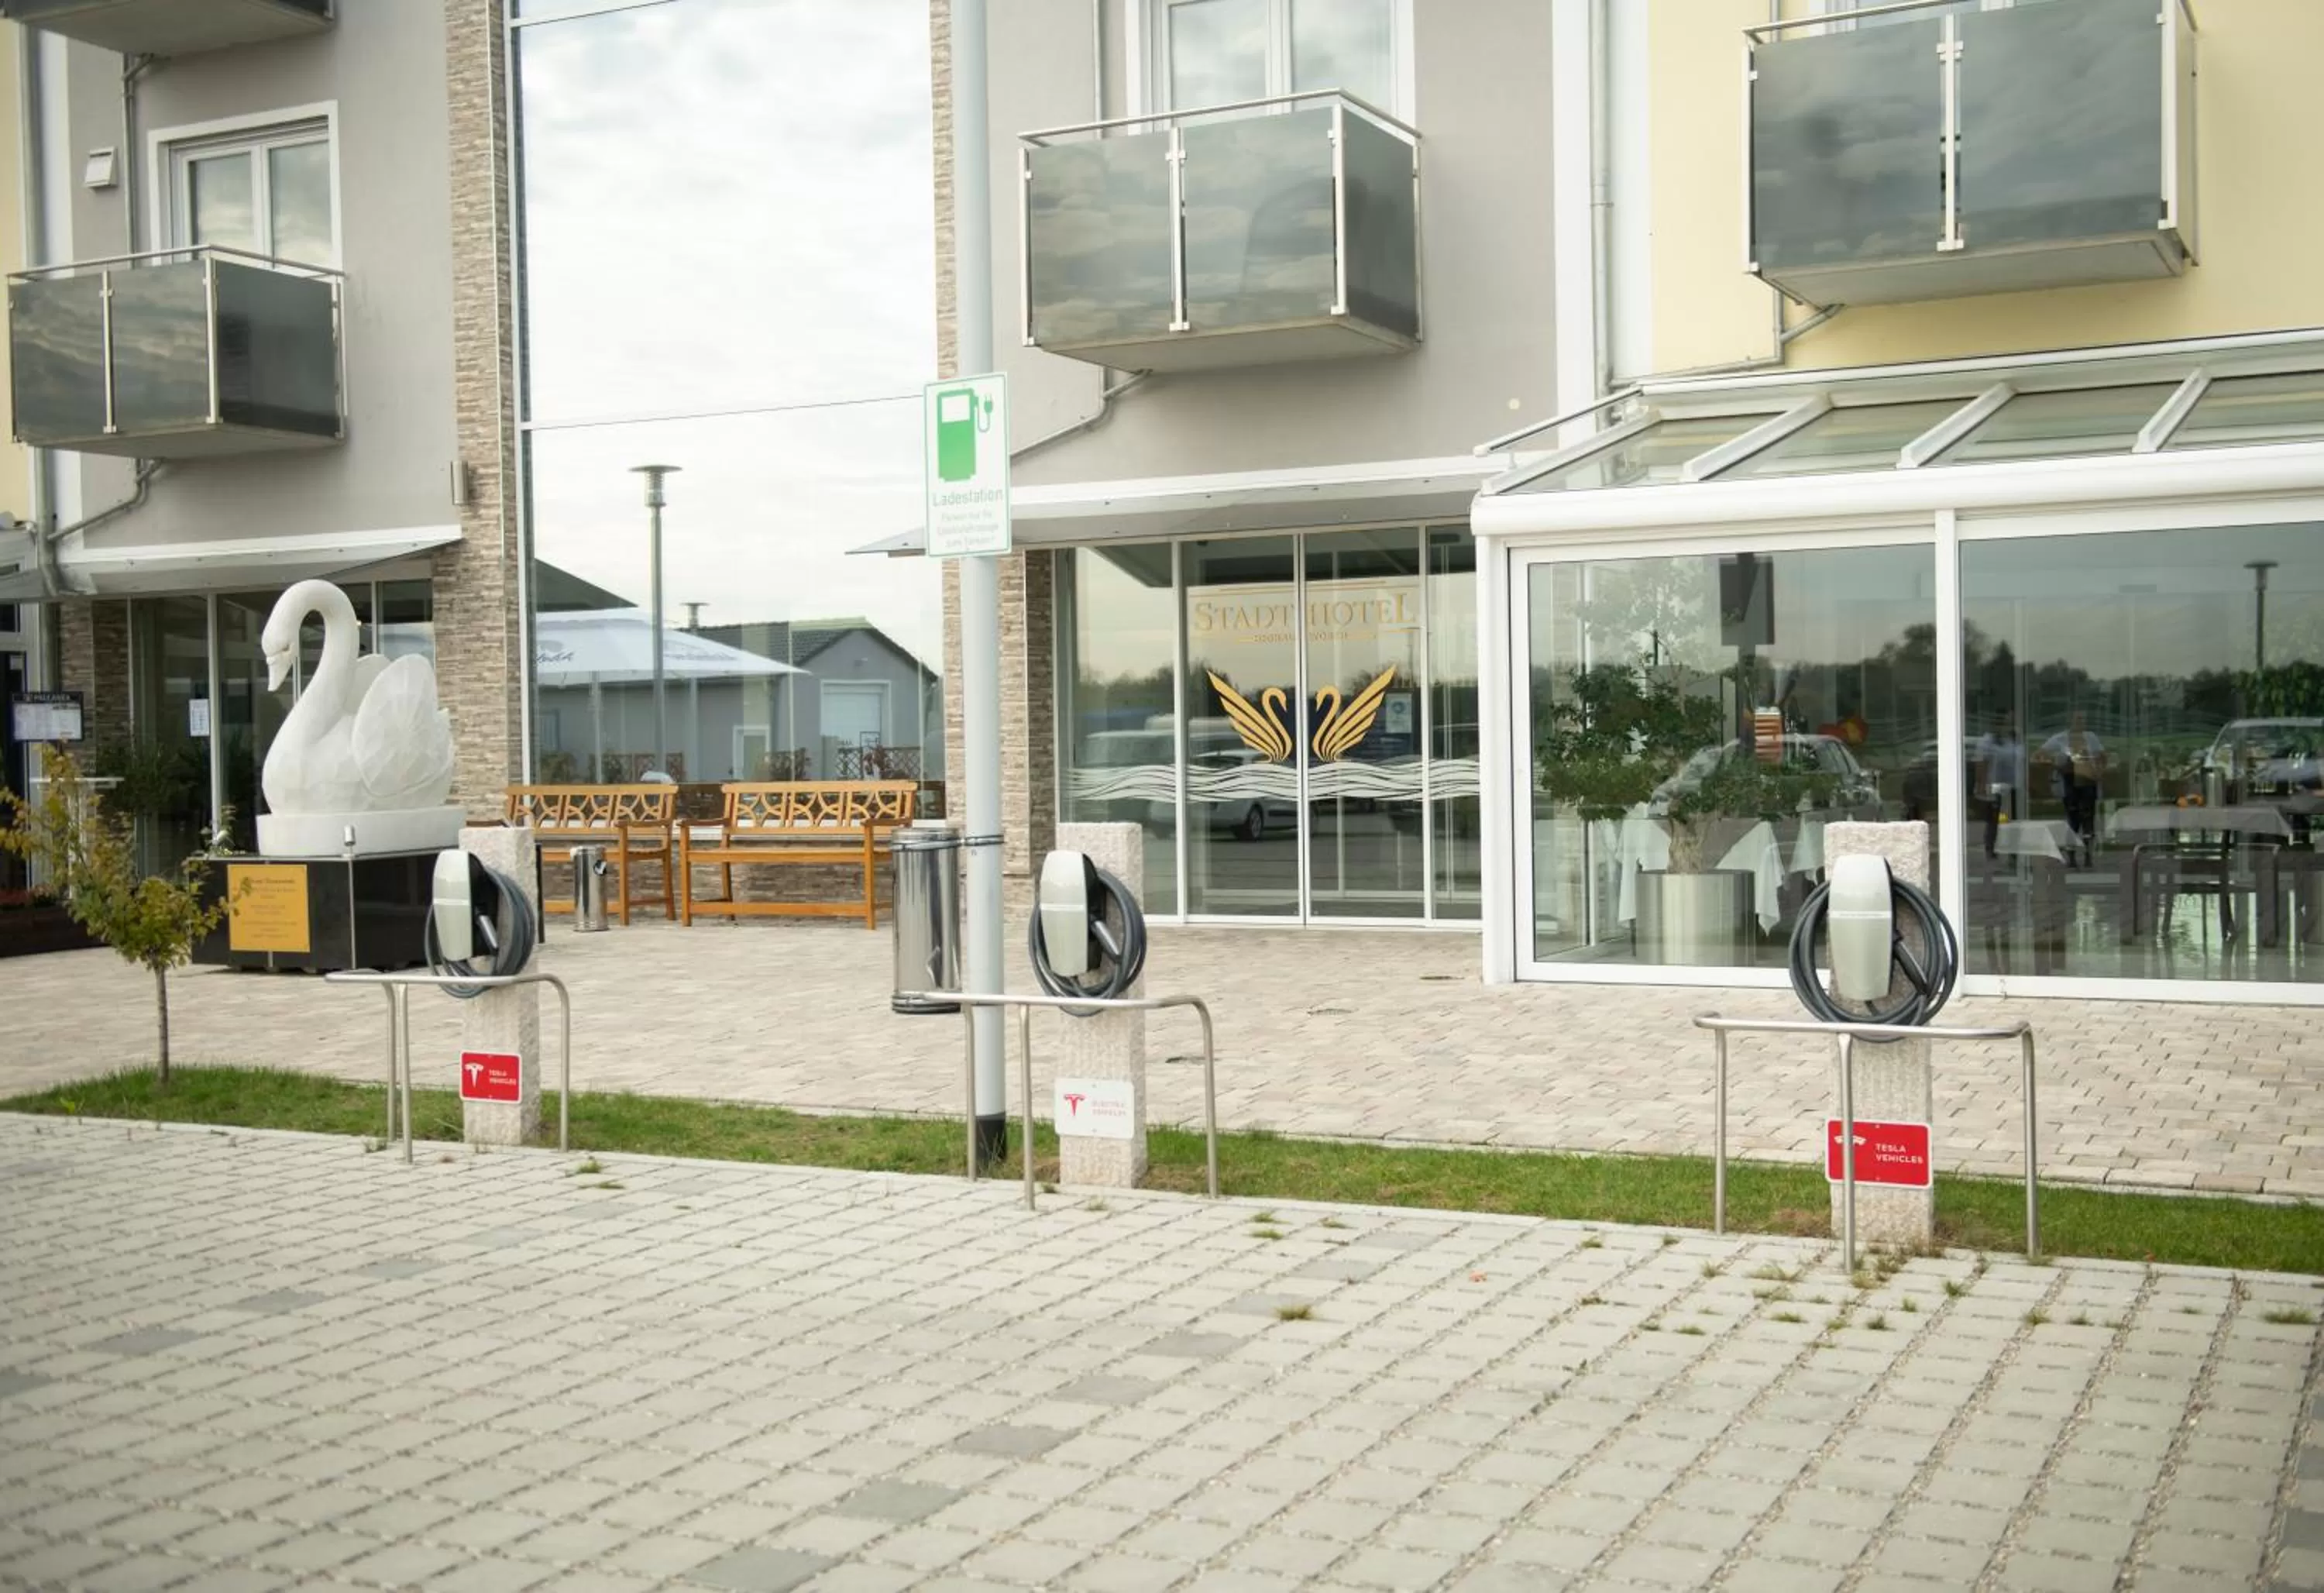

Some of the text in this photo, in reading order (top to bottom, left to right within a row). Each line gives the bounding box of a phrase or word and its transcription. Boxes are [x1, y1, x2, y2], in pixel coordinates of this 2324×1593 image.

[932, 488, 1004, 507] Ladestation
[1875, 1143, 1906, 1153] TESLA
[1875, 1154, 1923, 1165] VEHICLES
